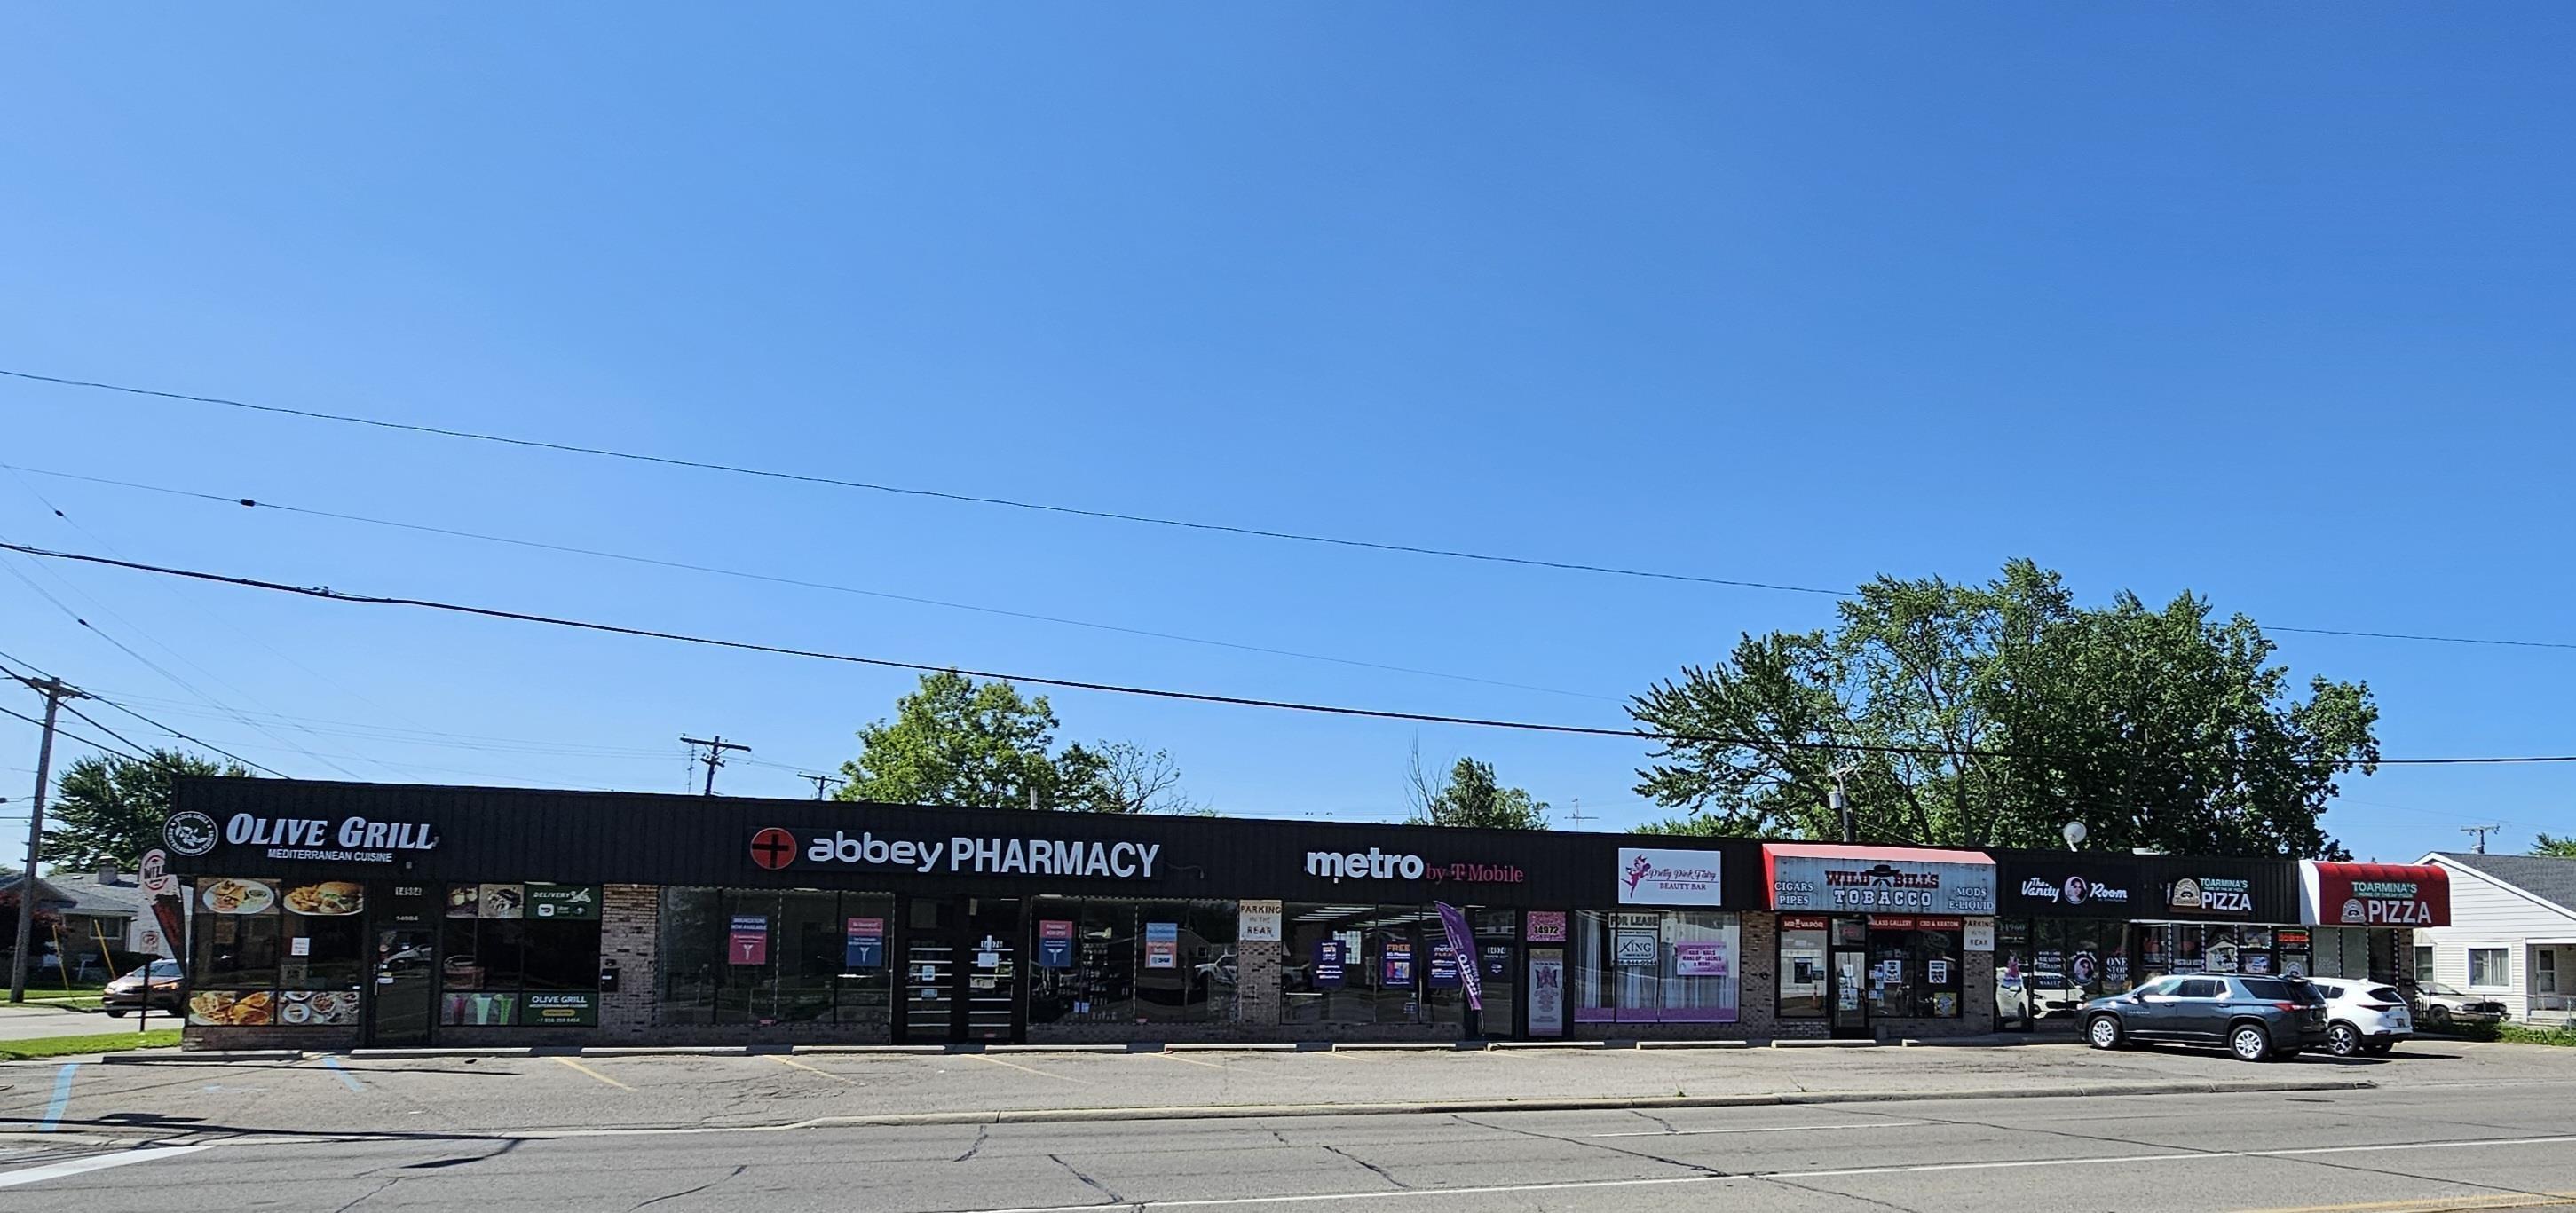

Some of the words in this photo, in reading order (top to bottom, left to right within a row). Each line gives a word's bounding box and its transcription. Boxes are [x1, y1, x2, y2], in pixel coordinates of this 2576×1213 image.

[226, 813, 328, 847] OLIVE
[338, 816, 435, 850] GRILL
[267, 848, 352, 861] MEDITERRANEAN
[353, 852, 392, 862] CUISINE
[808, 831, 944, 872] abbey
[951, 837, 1159, 877] PHARMACY
[1307, 847, 1424, 880] metro
[1426, 862, 1446, 886] by
[1648, 869, 1672, 880] Pretty
[1673, 870, 1695, 880] Pink
[1695, 870, 1718, 881] Fairy
[1825, 870, 1869, 886] WILD
[1893, 872, 1939, 888] BILL'S
[1774, 881, 1813, 893] CIGARS
[2199, 878, 2248, 888] TOARMINA'S
[2351, 881, 2418, 894] TOARMINA'S
[1833, 889, 1932, 907] TOBACCO
[1956, 887, 1987, 898] MODS
[2021, 881, 2059, 903] Vanity
[2089, 882, 2128, 899] Room
[1779, 895, 1809, 905] PIPES
[1948, 900, 1994, 910] E-LIQUID
[2201, 892, 2252, 910] PIZZA
[1241, 905, 1282, 914] PARKING
[2367, 900, 2432, 923] PIZZA
[1609, 915, 1628, 926] FOR
[1630, 915, 1658, 926] LEASE
[2106, 957, 2128, 966] ONE
